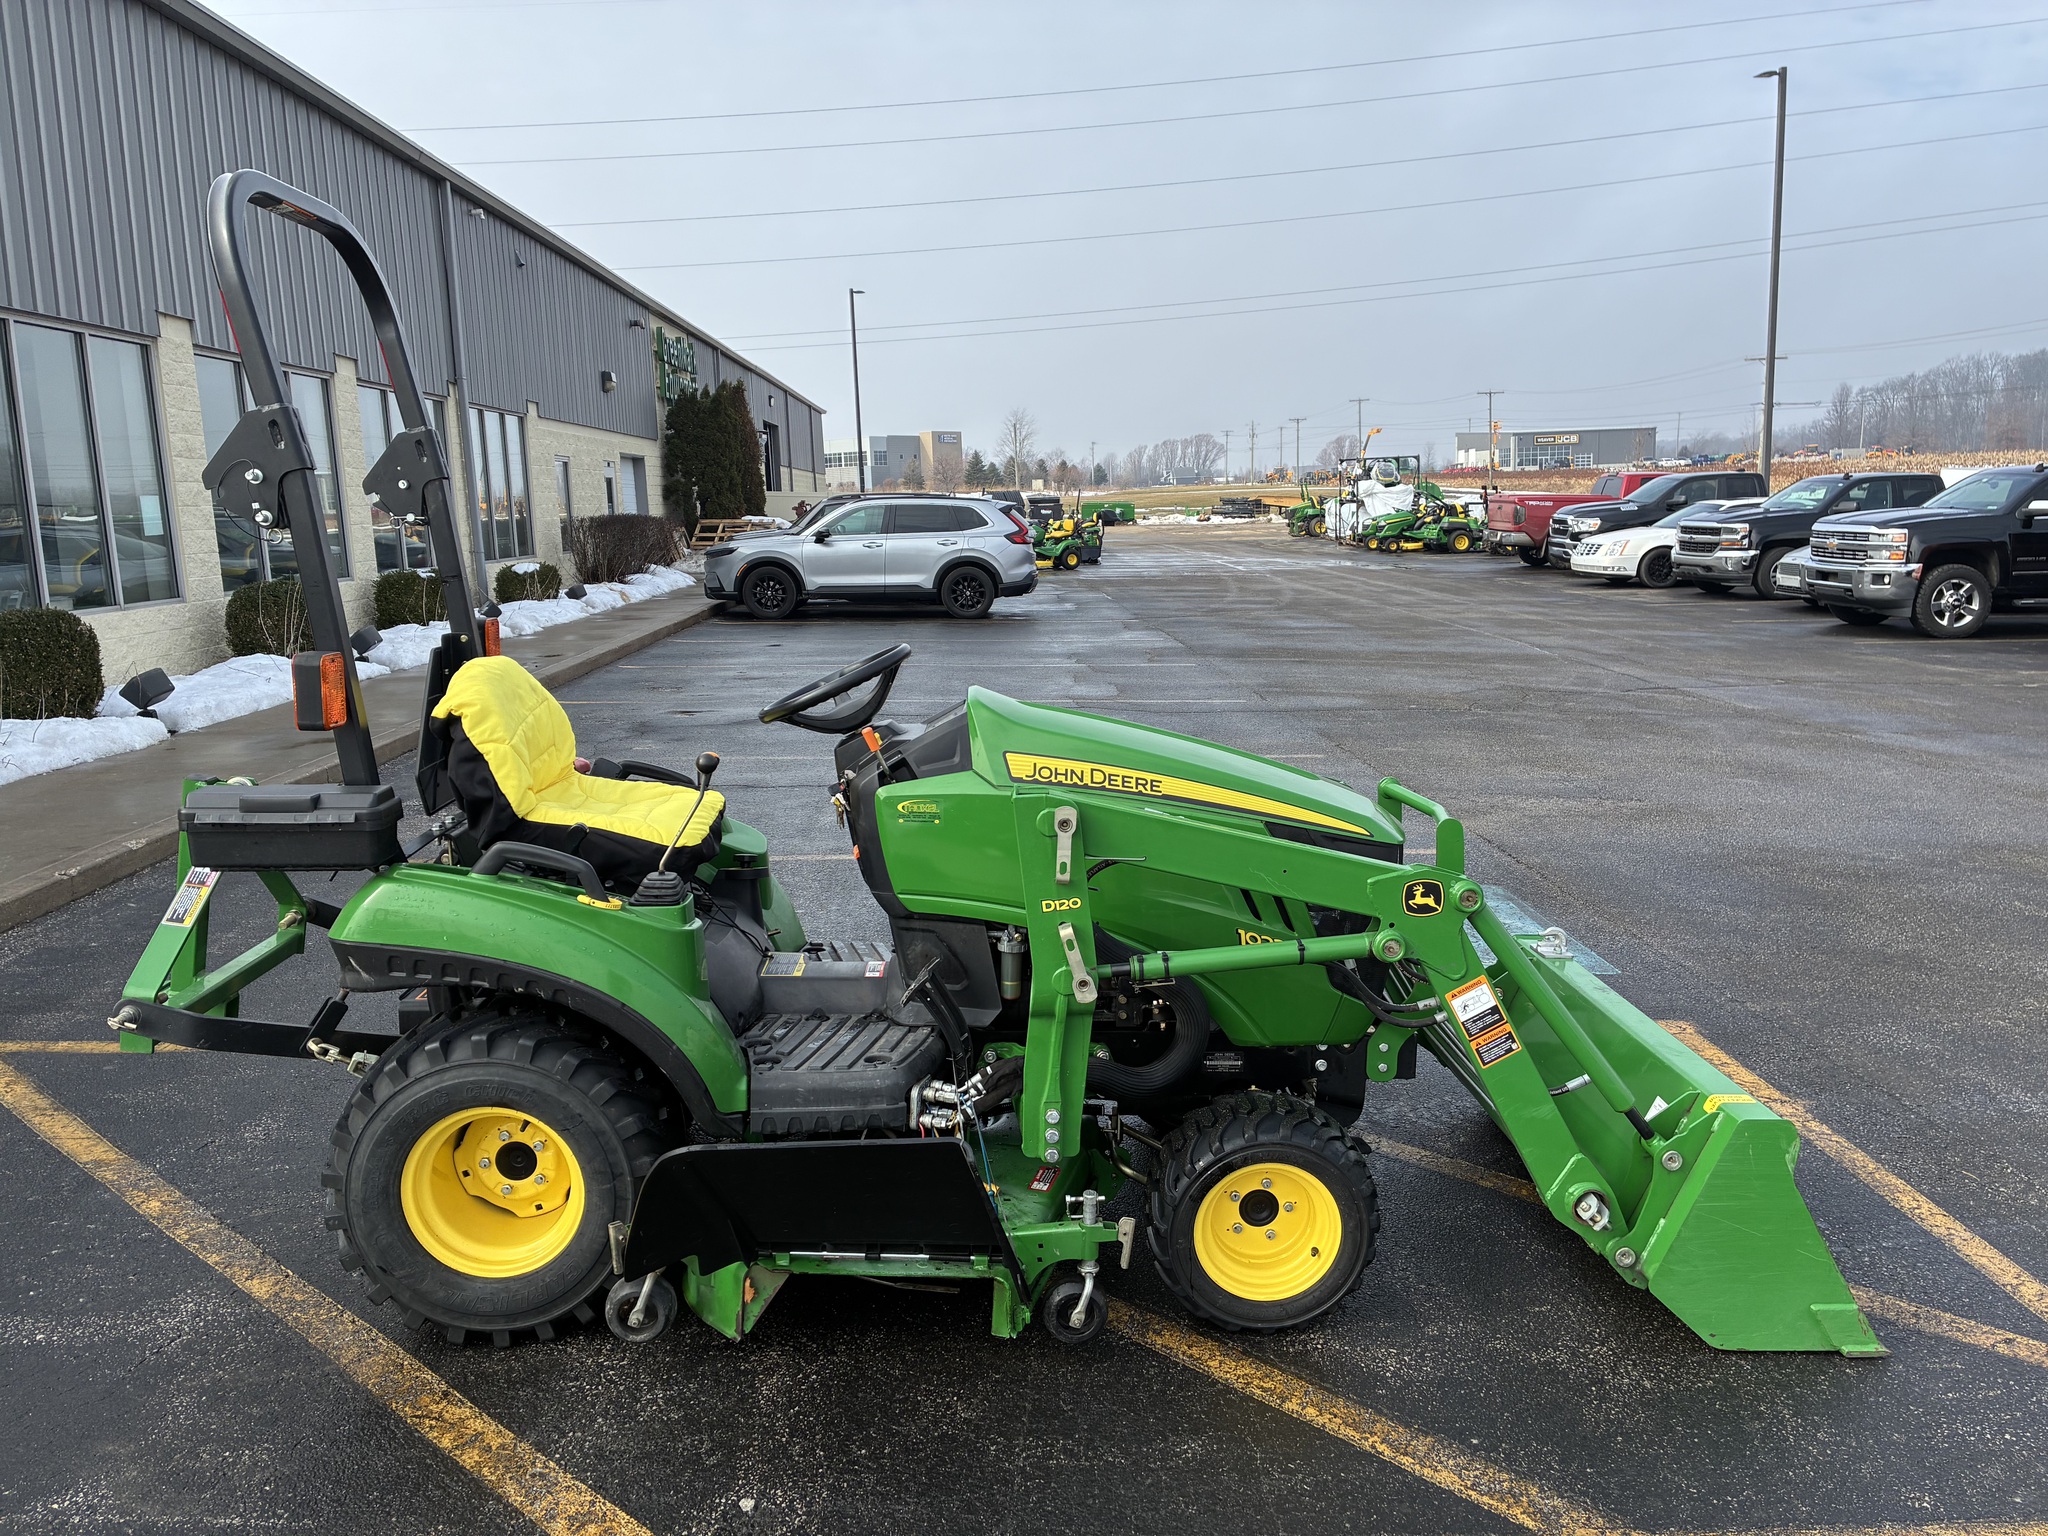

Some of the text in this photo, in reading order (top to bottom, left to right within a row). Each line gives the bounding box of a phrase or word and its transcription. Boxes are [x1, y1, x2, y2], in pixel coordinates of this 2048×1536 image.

[1556, 434, 1577, 444] JCB
[1025, 762, 1163, 793] JOHN DEERE
[1041, 897, 1082, 913] D120
[1457, 979, 1482, 996] WARNING
[1481, 1027, 1508, 1043] WARNING
